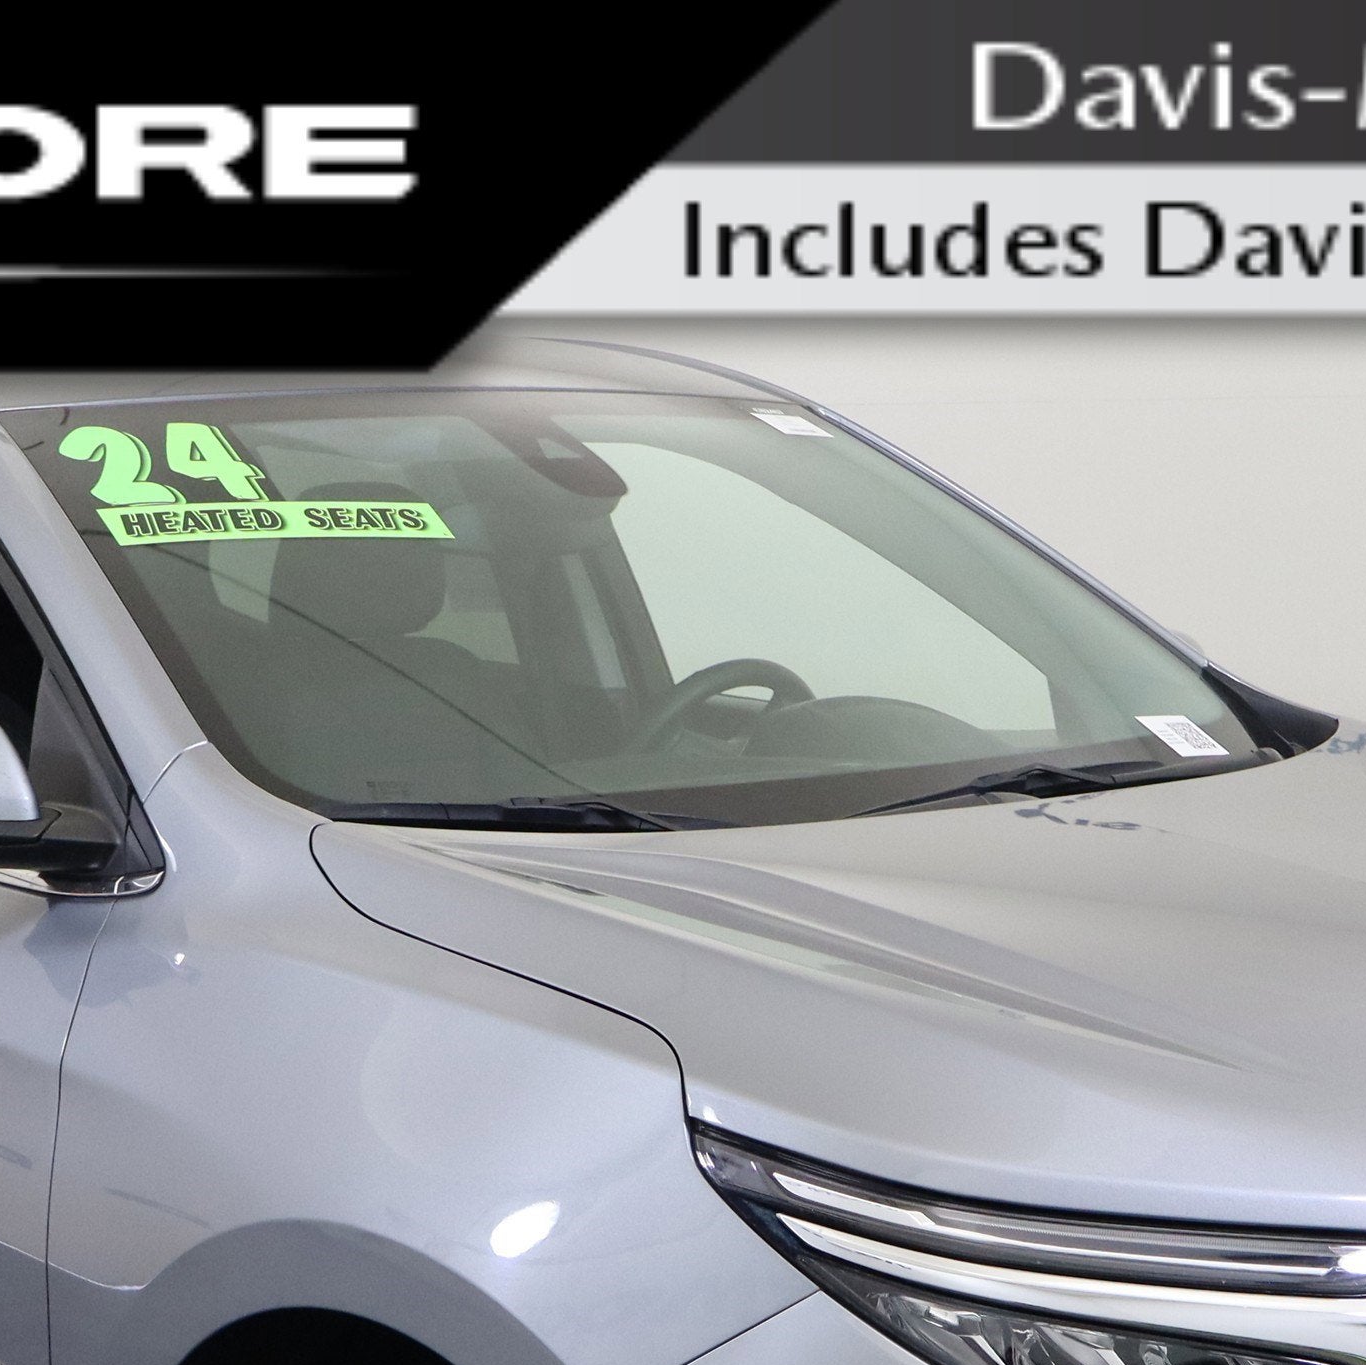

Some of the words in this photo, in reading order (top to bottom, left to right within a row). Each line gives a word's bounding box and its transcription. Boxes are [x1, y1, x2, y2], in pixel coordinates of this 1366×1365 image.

[58, 421, 270, 506] 24
[119, 508, 283, 537] HEATED
[306, 507, 429, 532] SEATS
